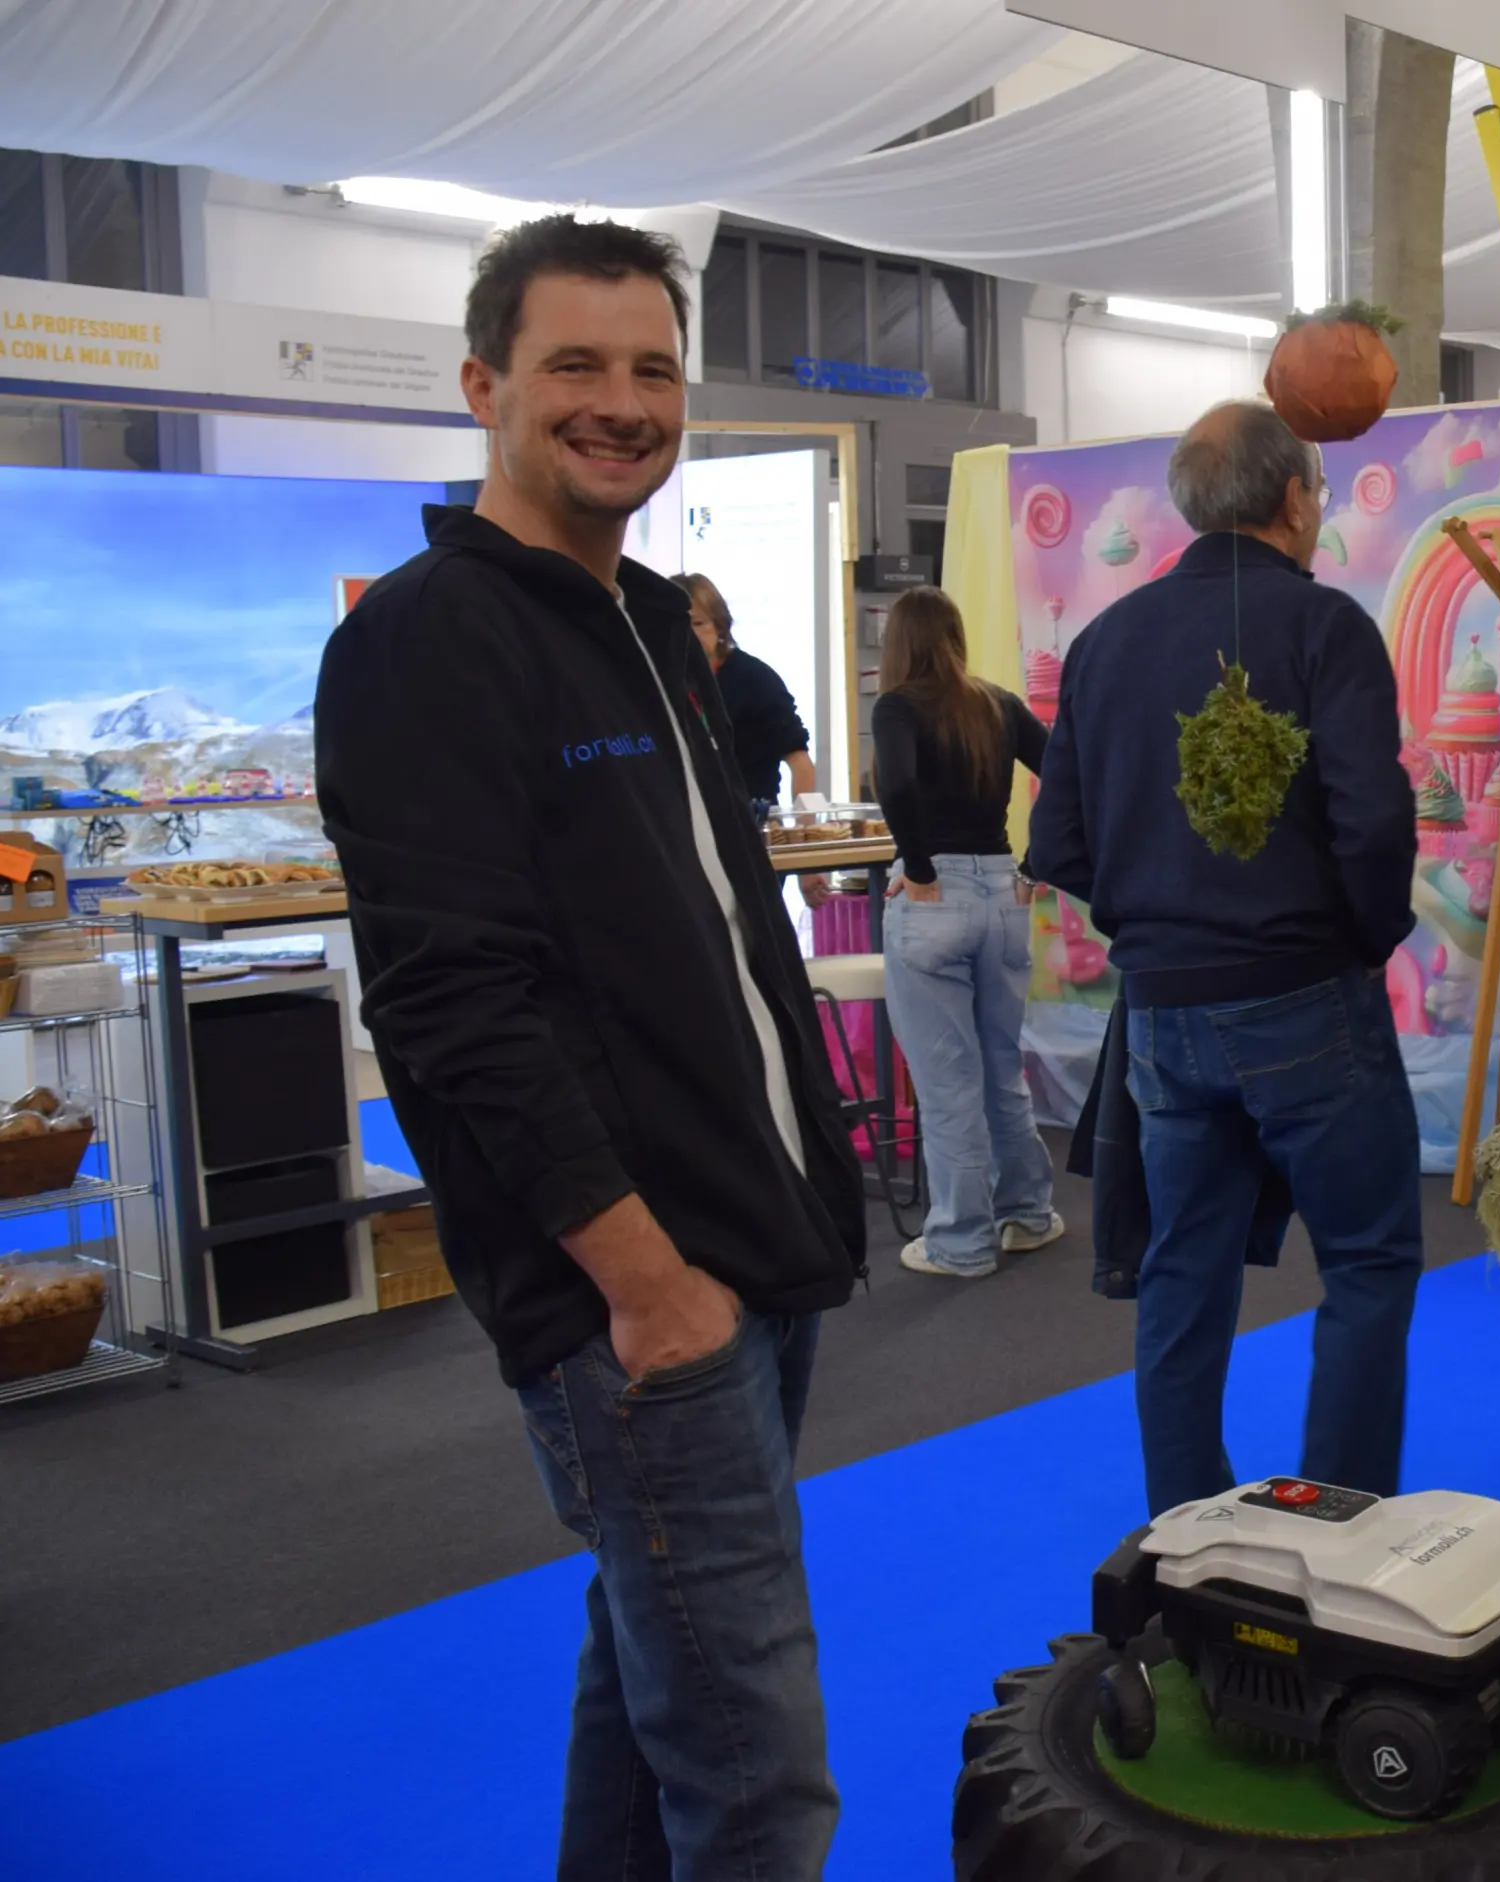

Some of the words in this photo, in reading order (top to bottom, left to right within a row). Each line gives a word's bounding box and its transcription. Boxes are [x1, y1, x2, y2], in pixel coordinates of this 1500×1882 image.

[4, 311, 27, 331] LA
[31, 313, 148, 342] PROFESSIONE
[12, 340, 47, 360] CON
[53, 344, 75, 363] LA
[79, 347, 111, 367] MIA
